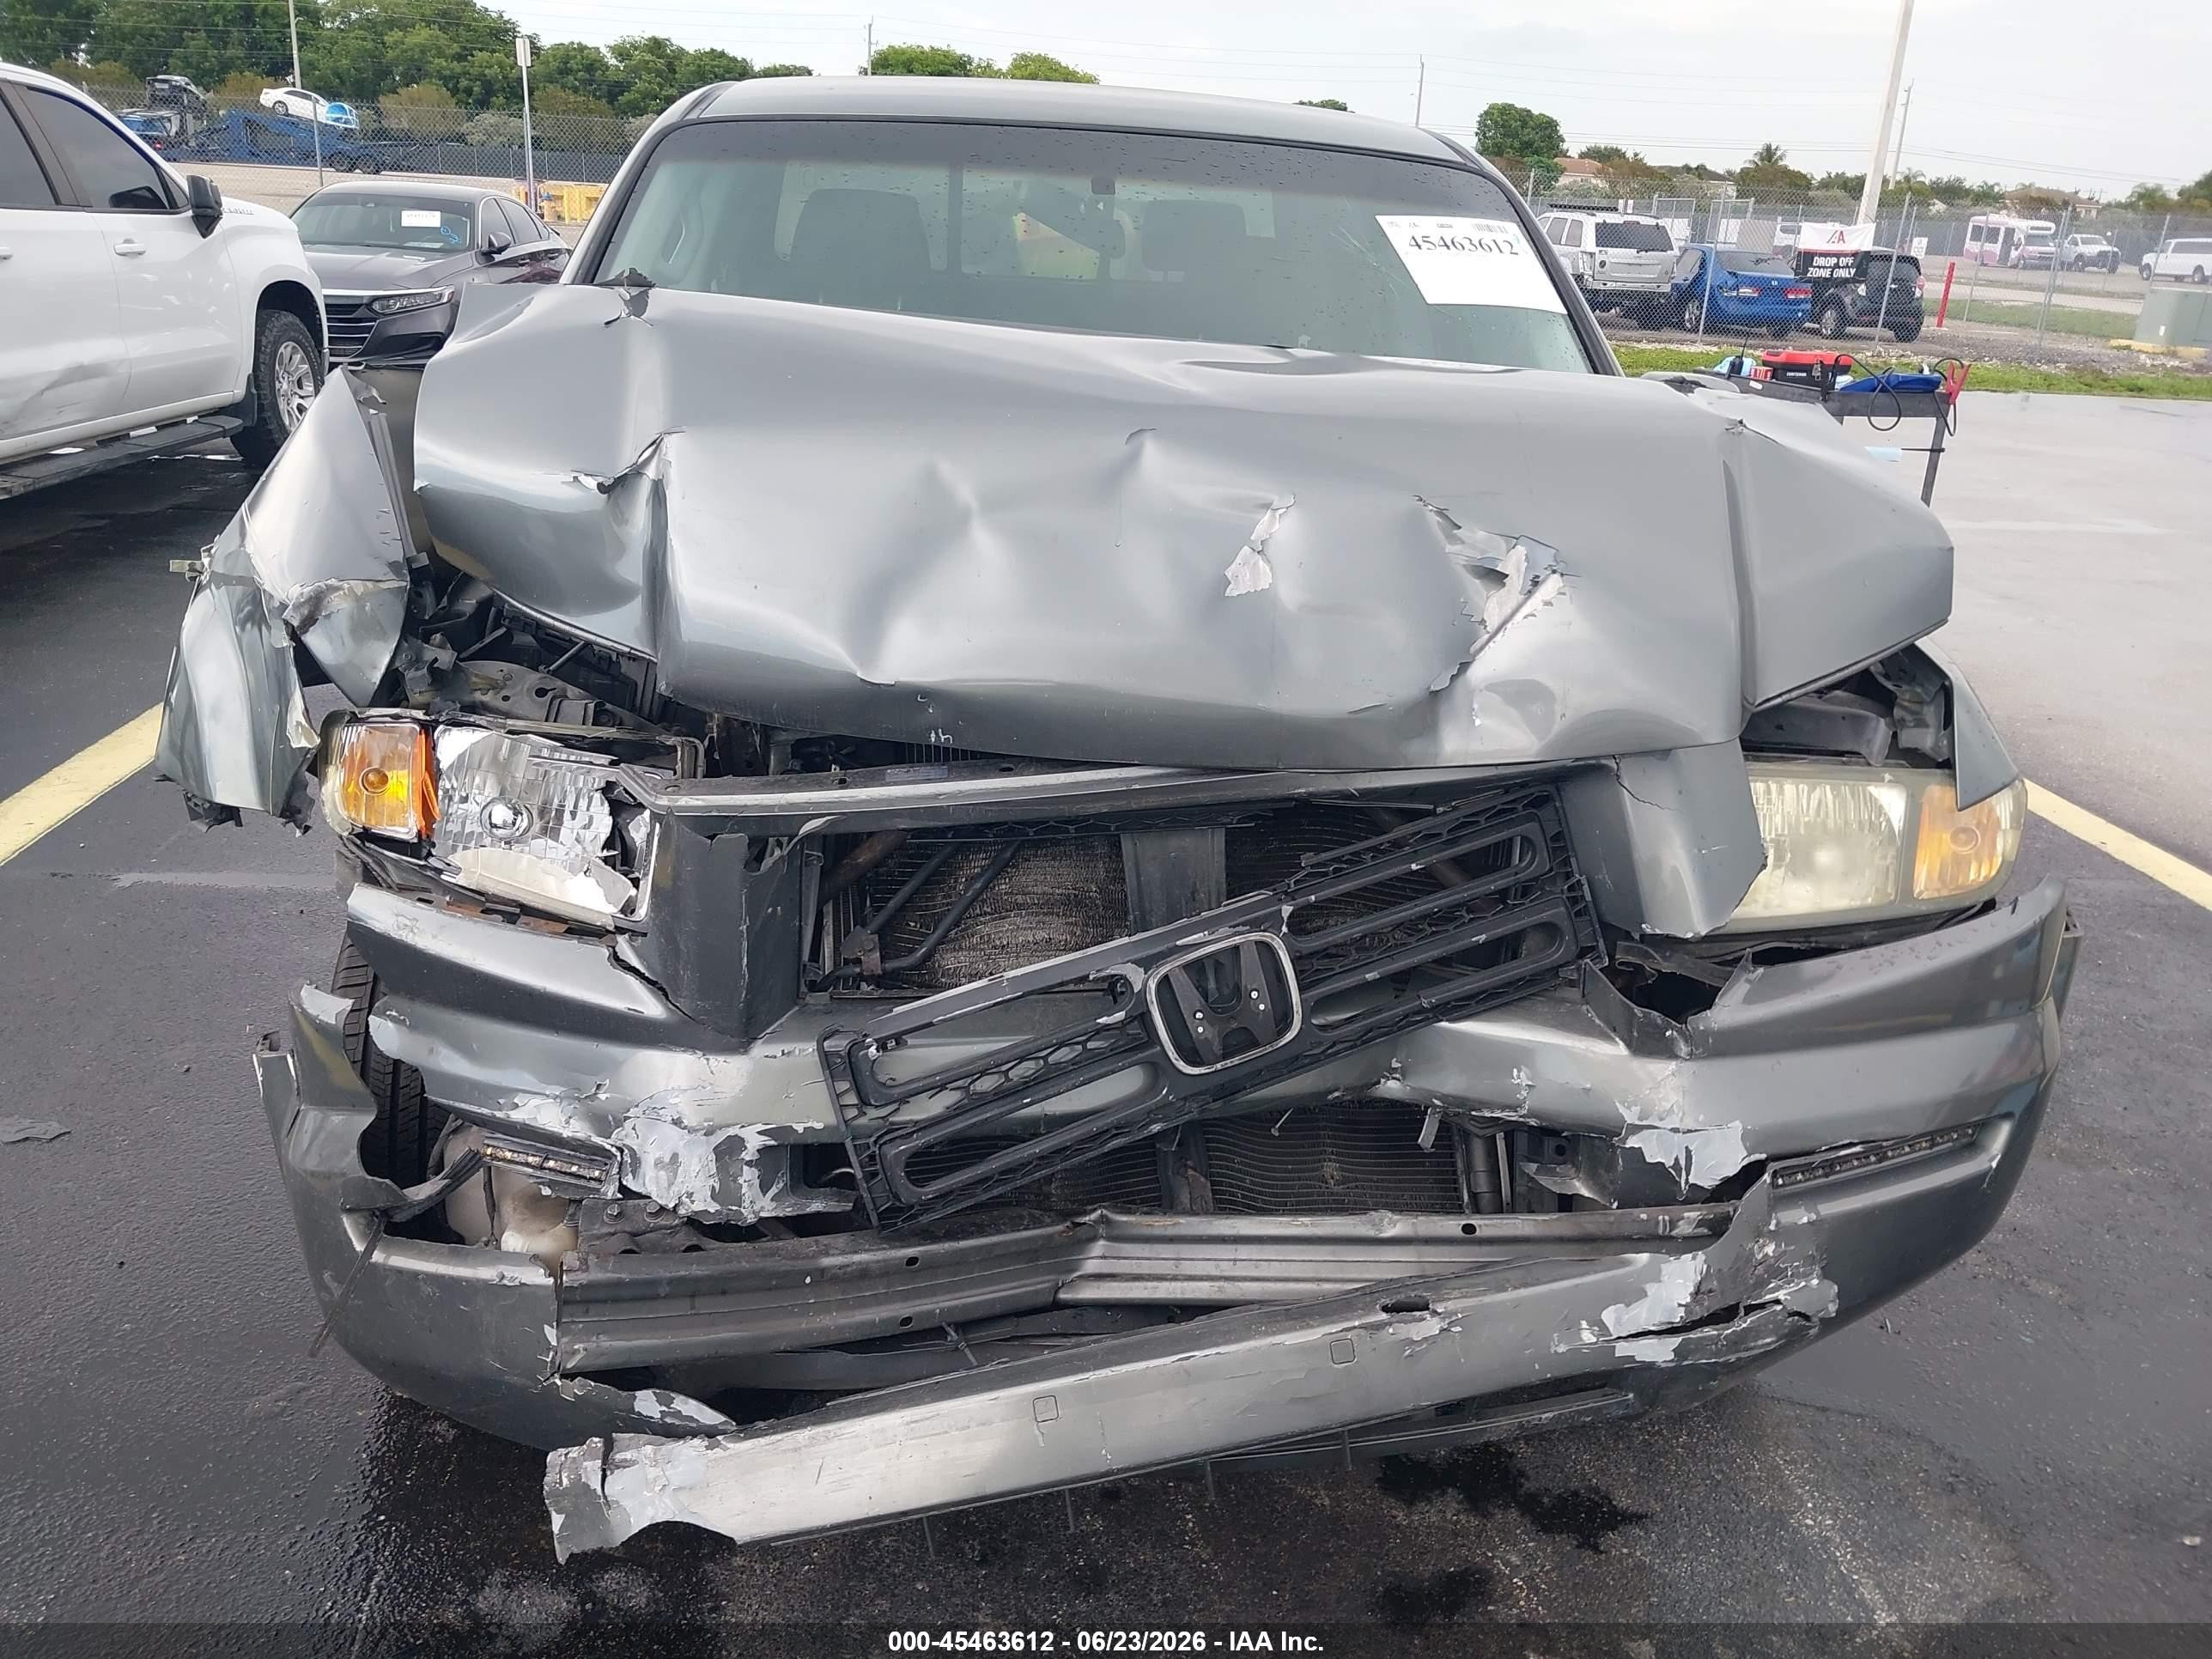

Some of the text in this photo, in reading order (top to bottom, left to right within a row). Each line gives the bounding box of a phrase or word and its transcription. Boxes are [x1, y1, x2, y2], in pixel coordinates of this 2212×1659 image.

[1408, 235, 1519, 256] 45463612
[1813, 256, 1855, 267] DROP OFF
[1807, 267, 1856, 278] ZONE ONLY
